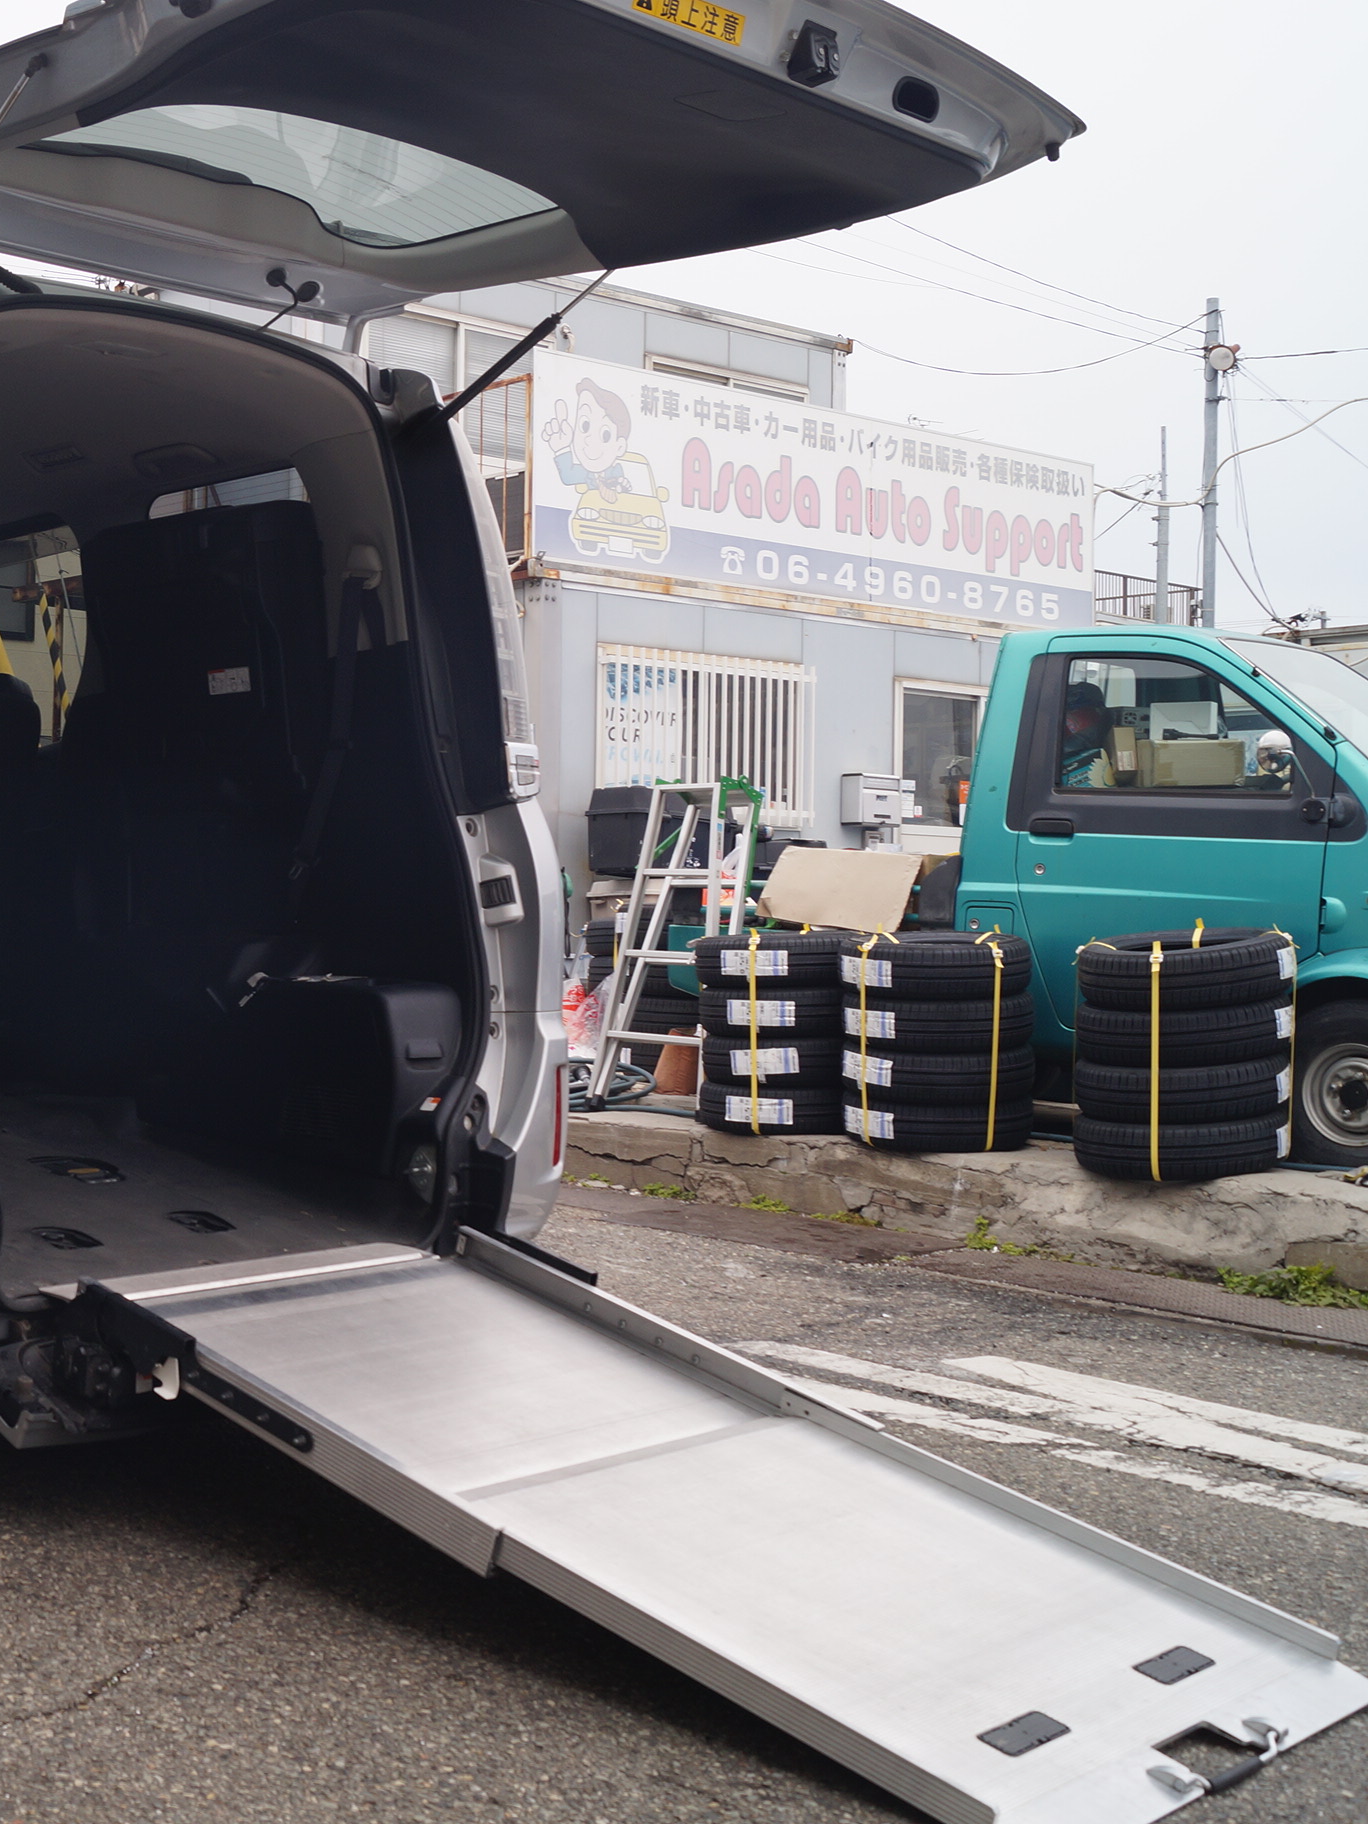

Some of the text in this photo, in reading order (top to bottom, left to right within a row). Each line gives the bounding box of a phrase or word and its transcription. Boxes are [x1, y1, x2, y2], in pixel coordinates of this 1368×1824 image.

[660, 0, 739, 42] 頭上注意
[681, 436, 1083, 577] Asada Auto Support
[756, 549, 1060, 621] 06-4960-8765
[605, 725, 641, 743] OUR
